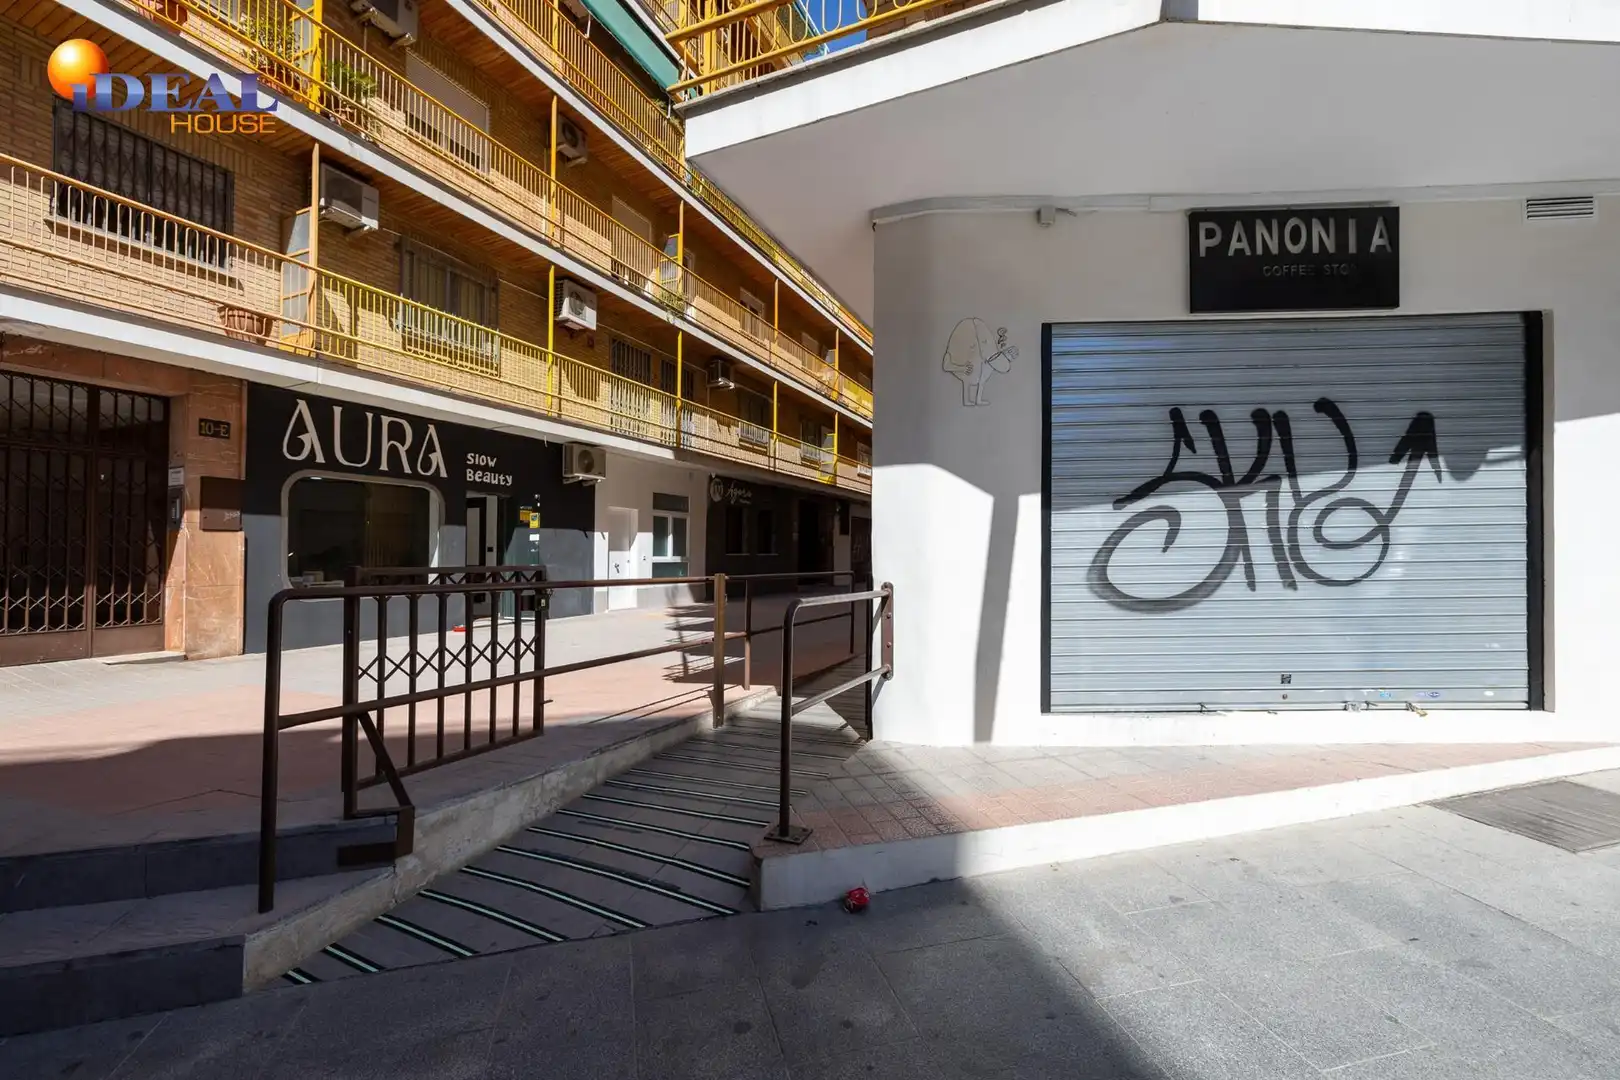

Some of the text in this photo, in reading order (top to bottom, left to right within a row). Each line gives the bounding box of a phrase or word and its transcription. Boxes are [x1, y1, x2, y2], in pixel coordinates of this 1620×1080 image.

[1199, 216, 1392, 257] PANONIA
[1263, 264, 1316, 277] COFFEE
[200, 421, 229, 437] 10-E
[283, 399, 448, 478] AURA
[466, 468, 512, 486] Beauty
